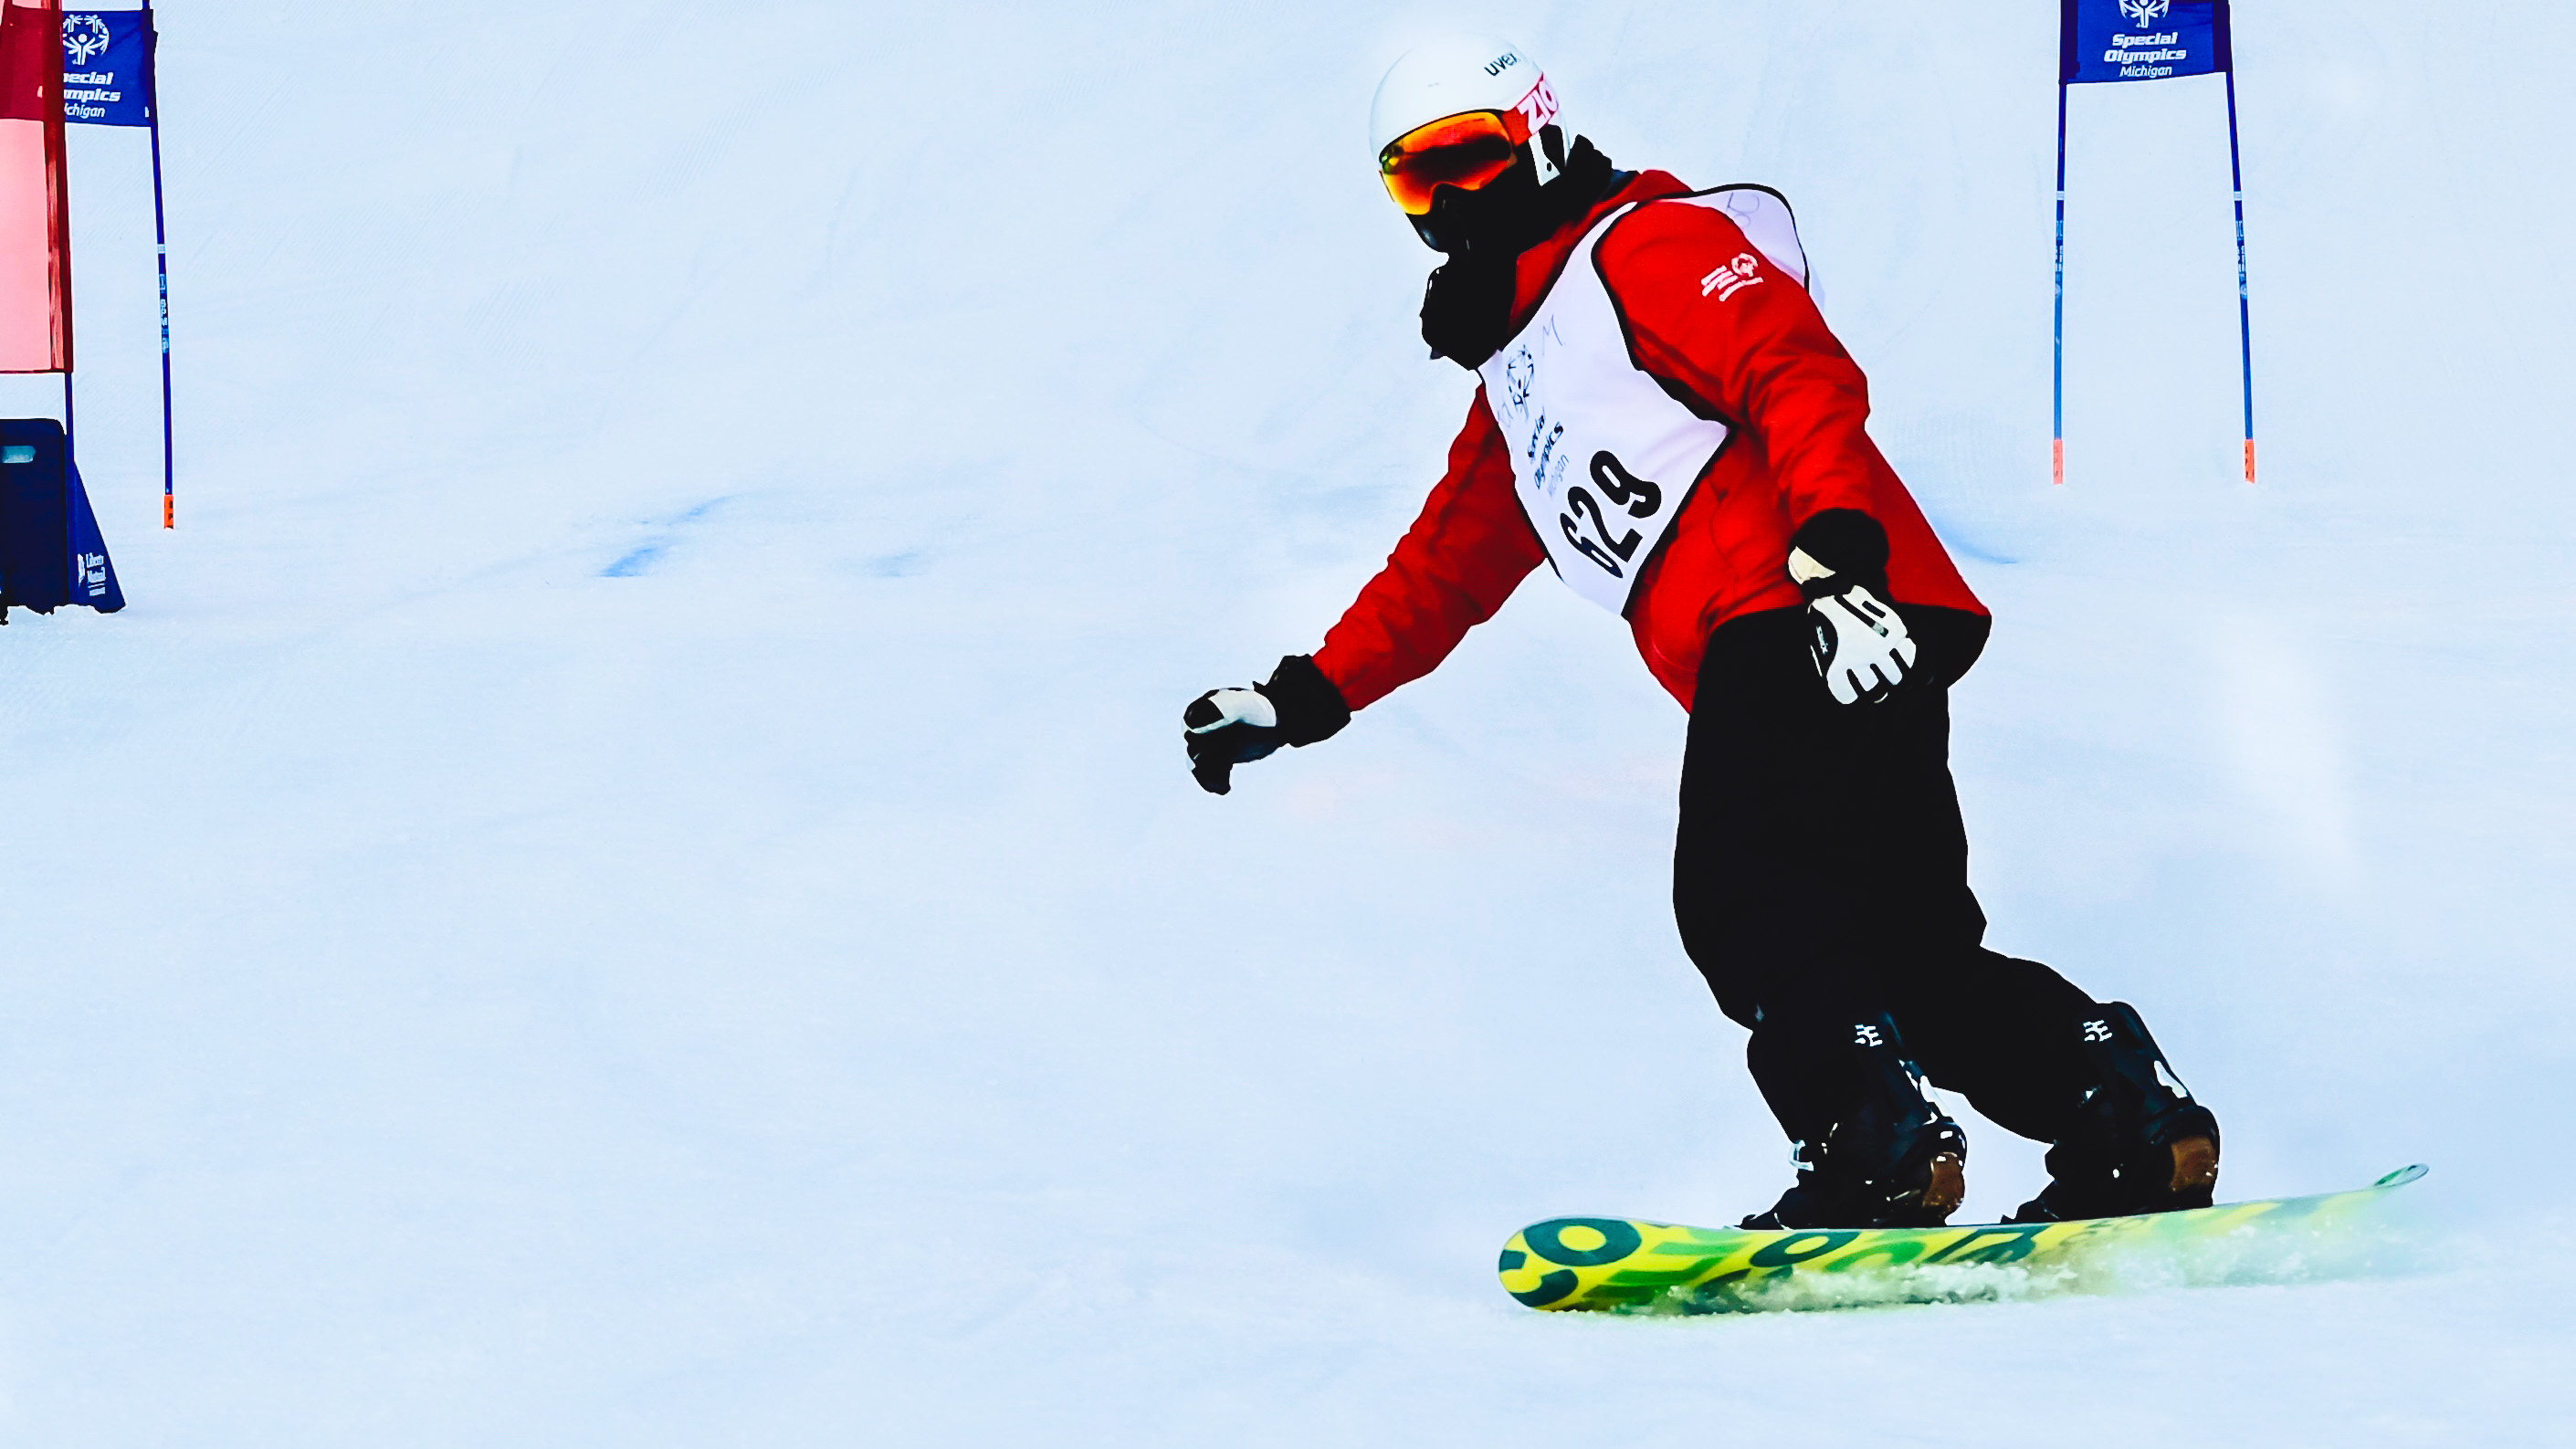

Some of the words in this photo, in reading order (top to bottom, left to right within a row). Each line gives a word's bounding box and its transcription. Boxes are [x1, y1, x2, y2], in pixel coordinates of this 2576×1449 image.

[2112, 31, 2179, 48] Special
[2103, 48, 2187, 65] Olympics
[63, 71, 114, 85] pecial
[2119, 65, 2173, 79] Michigan
[63, 88, 121, 103] mpics
[64, 102, 106, 120] ichigan
[1560, 450, 1662, 579] 629
